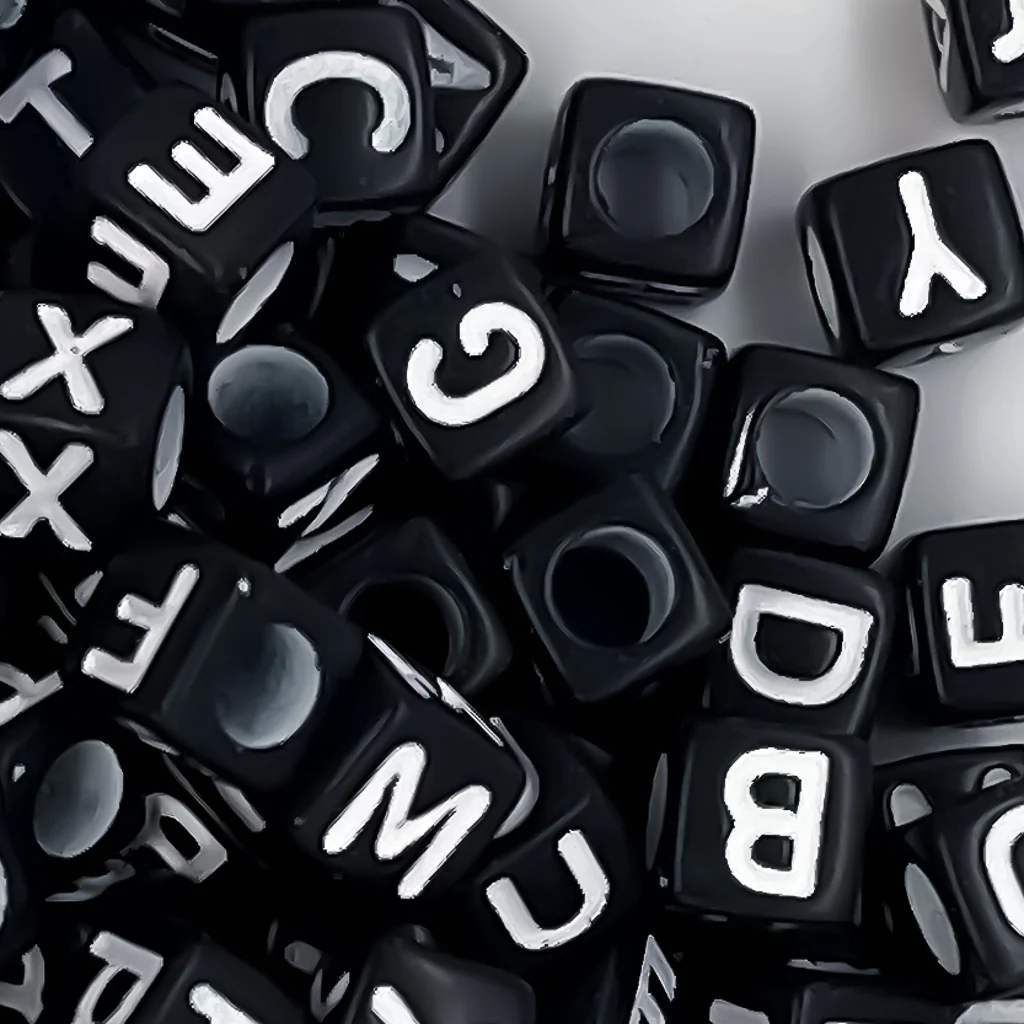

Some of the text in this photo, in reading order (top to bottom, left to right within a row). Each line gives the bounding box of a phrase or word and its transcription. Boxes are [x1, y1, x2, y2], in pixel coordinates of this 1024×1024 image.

[265, 51, 410, 159] C
[128, 107, 275, 231] E
[899, 171, 986, 317] Y
[0, 304, 133, 414] X
[407, 302, 545, 425] G
[82, 564, 199, 693] F
[730, 585, 873, 705] D
[724, 747, 829, 898] B
